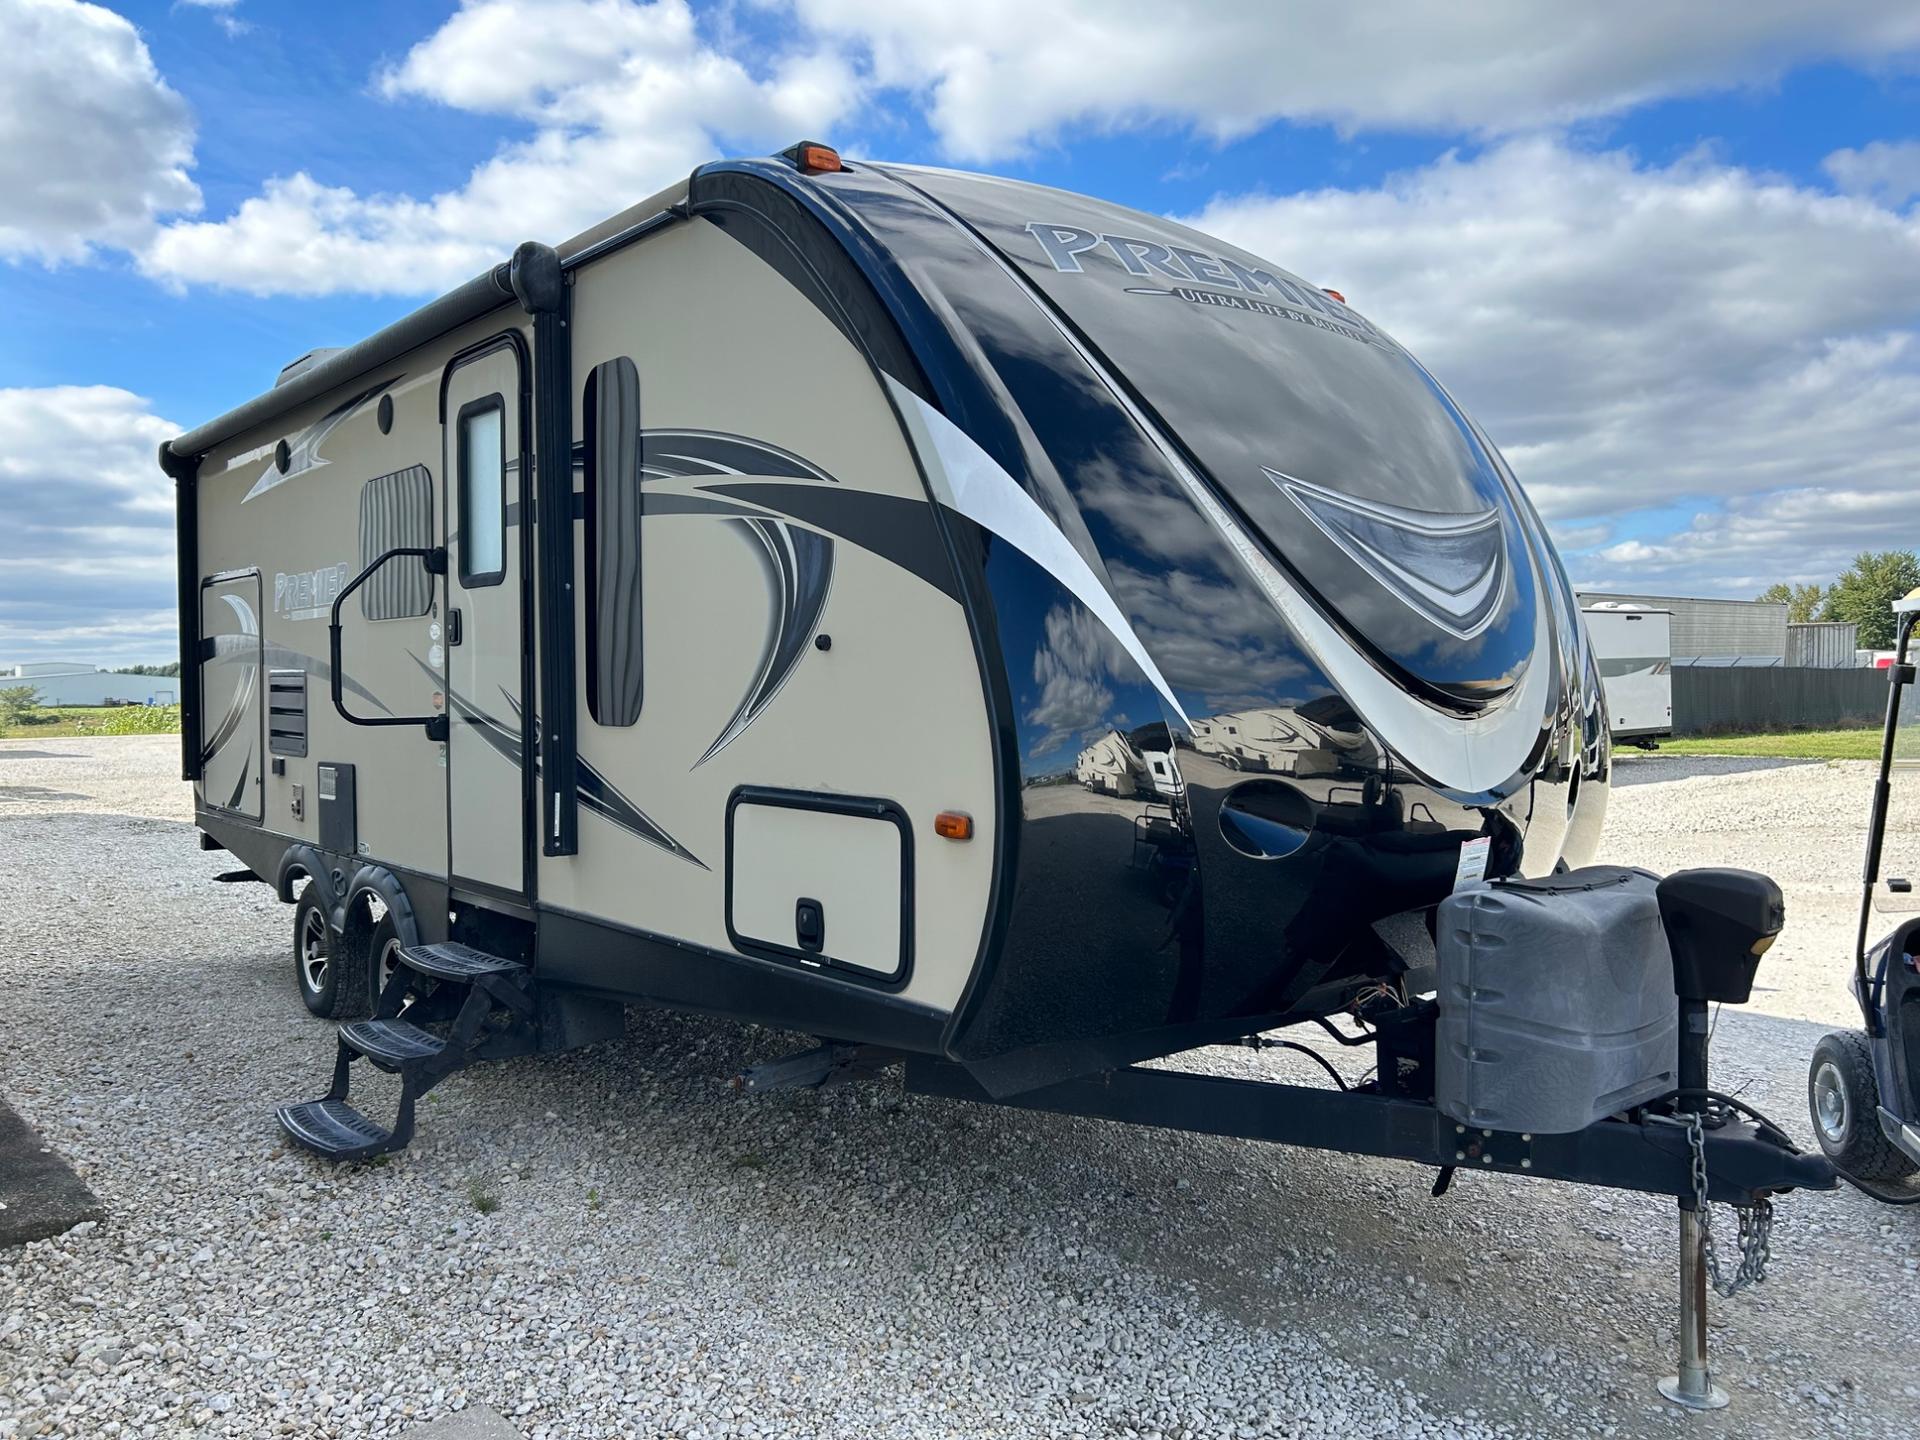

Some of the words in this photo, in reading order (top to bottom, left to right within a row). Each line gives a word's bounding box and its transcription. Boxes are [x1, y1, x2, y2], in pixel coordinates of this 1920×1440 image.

[1179, 287, 1242, 309] ULTRA
[1244, 299, 1285, 318] LITE
[1288, 310, 1307, 323] BY
